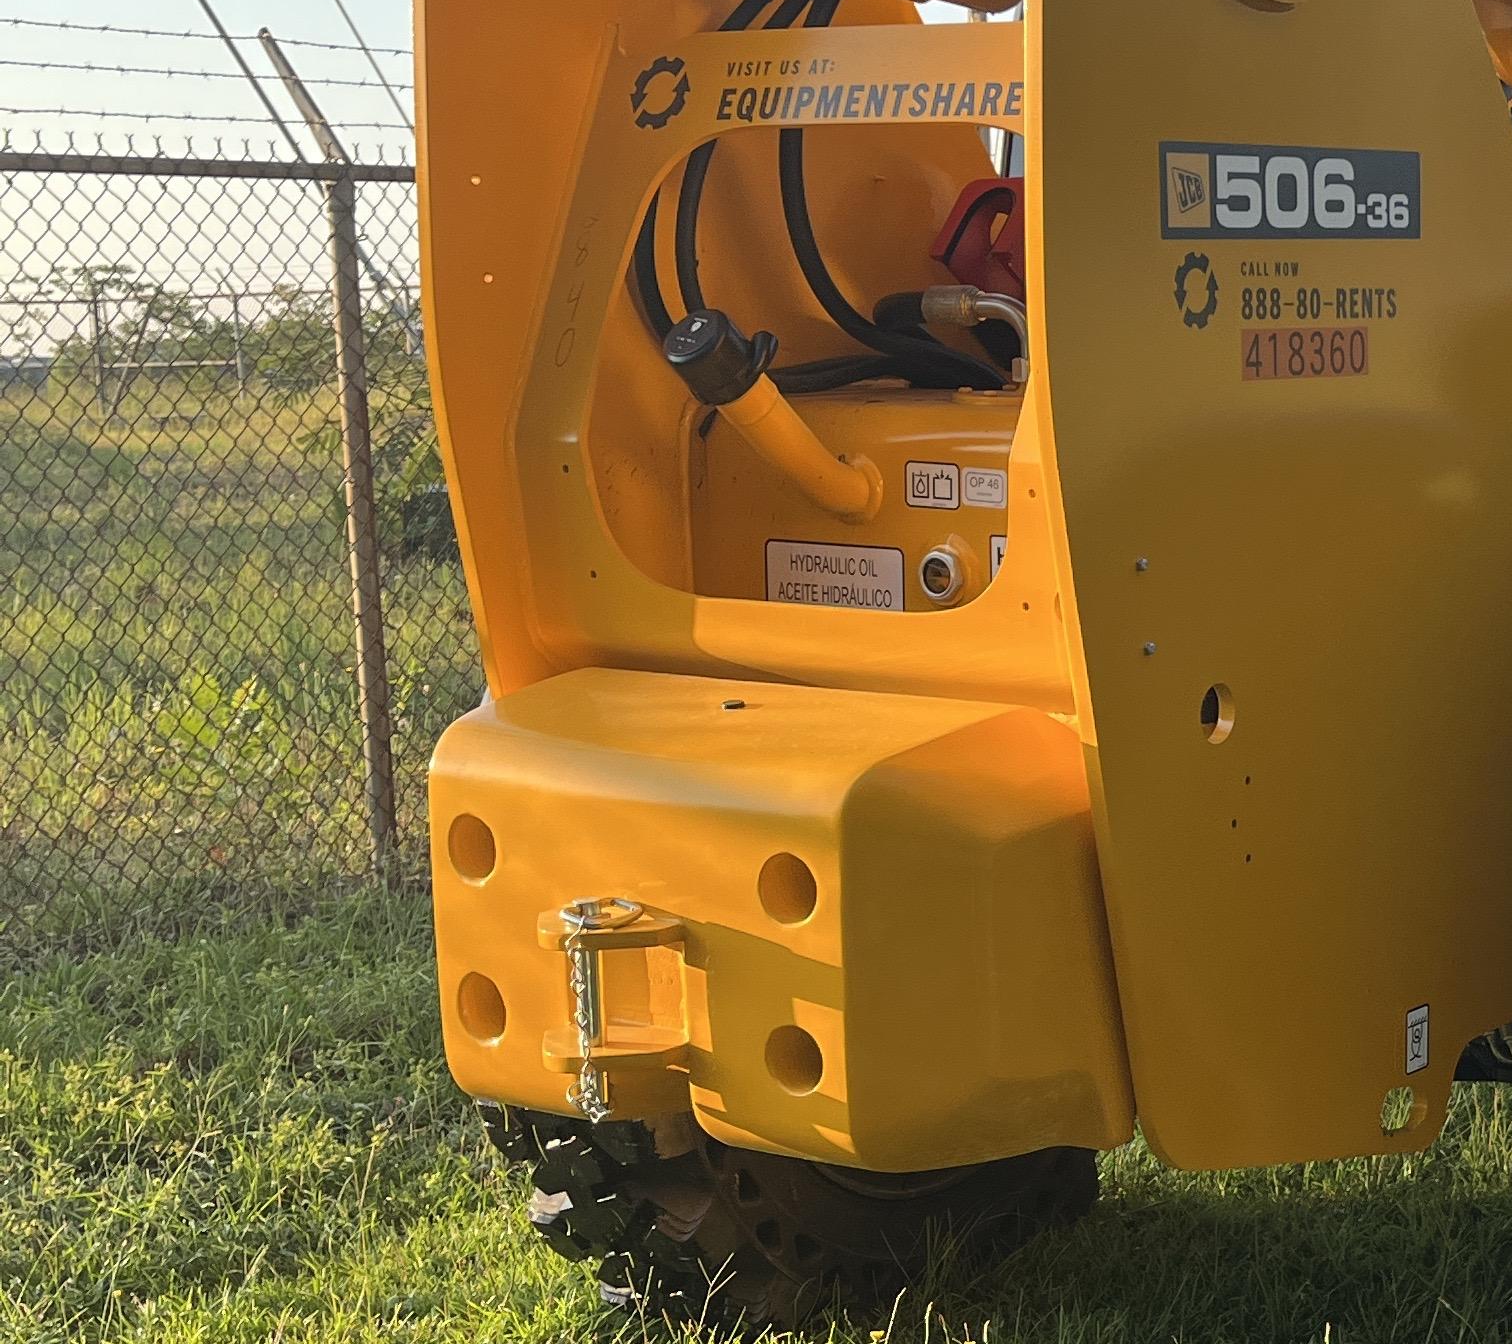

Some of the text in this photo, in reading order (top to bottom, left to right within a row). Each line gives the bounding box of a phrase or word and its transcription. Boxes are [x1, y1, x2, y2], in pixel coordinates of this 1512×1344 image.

[727, 59, 836, 76] VISIT US AT:
[717, 81, 1024, 122] EQUIPMENTSHARE
[1178, 172, 1204, 208] JCB
[1215, 154, 1410, 229] 506-36
[1240, 261, 1299, 277] CALL NOW
[1241, 287, 1397, 320] 888-80-RENTS
[1245, 330, 1366, 377] 418360
[790, 554, 878, 578] HYDRAULIC OIL
[778, 581, 892, 608] ACEITE HIDRÁULICO
